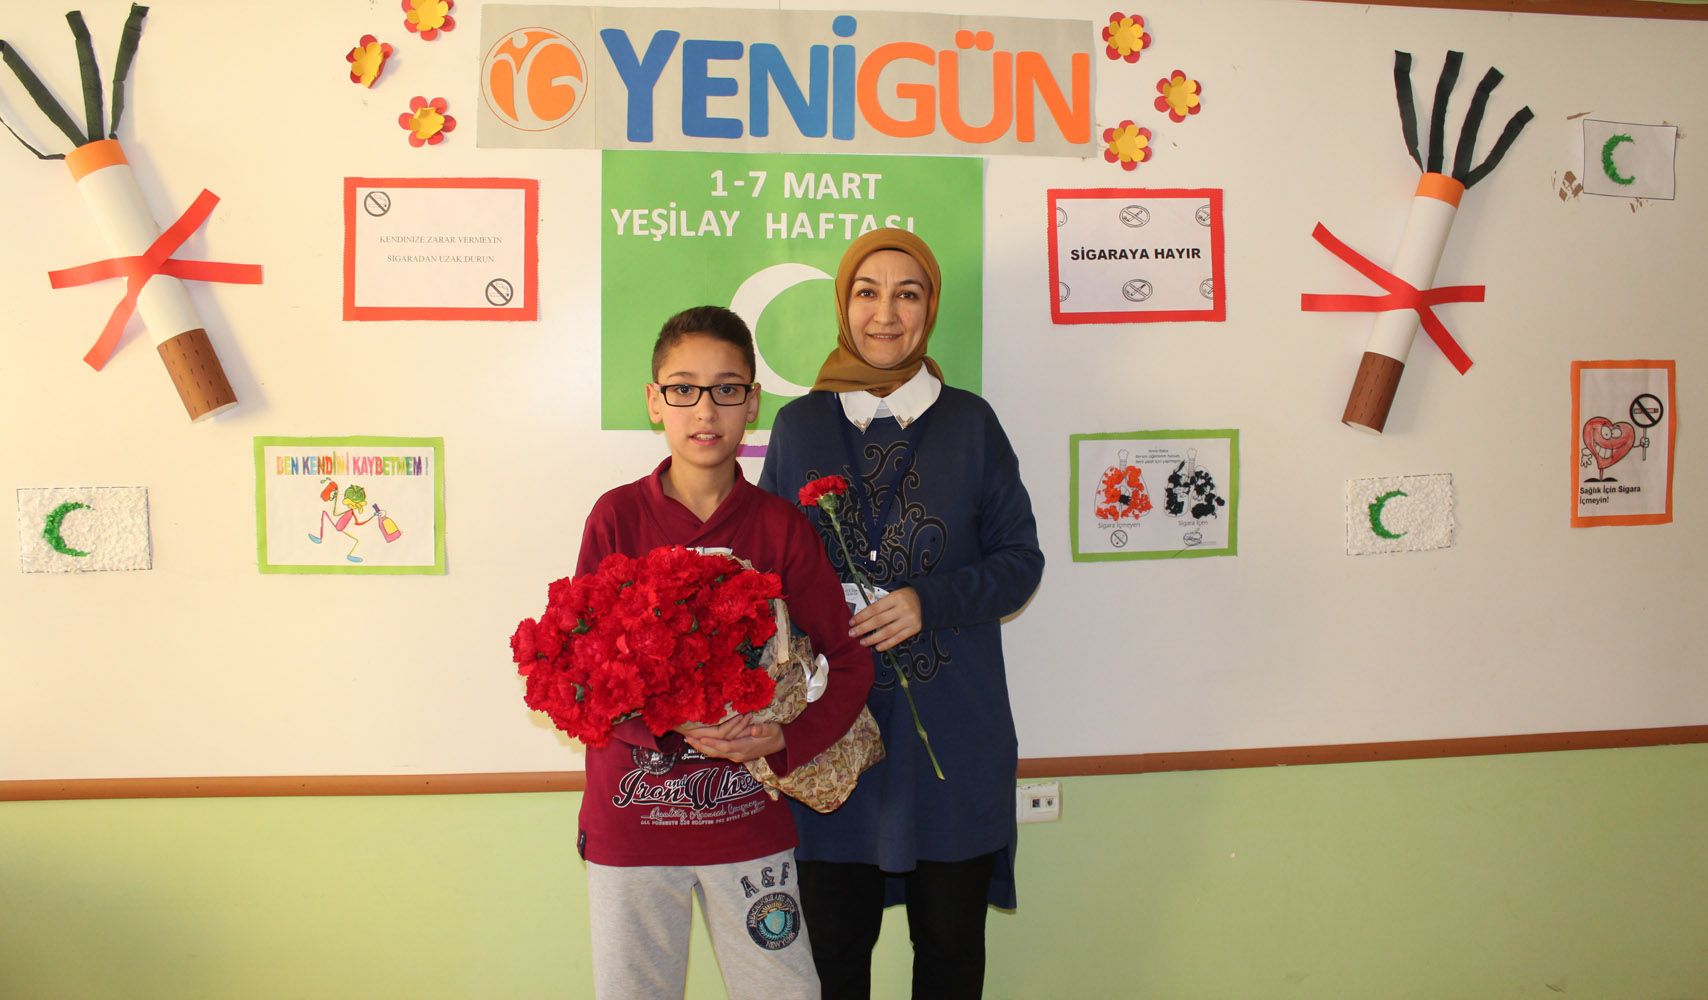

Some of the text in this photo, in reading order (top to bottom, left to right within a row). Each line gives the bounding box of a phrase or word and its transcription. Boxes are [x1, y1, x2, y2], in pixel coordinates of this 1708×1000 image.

[600, 15, 1091, 144] YENİGÜN
[710, 169, 882, 200] 1-7 MART
[610, 202, 740, 242] YEŞİLAY
[427, 235, 456, 244] ZARAR
[439, 255, 463, 263] UZAK
[464, 255, 495, 263] DURUN
[1070, 246, 1202, 261] SİGARAYA HAYIR
[276, 456, 299, 476] BEN
[353, 455, 423, 476] KAYBETMEM
[1580, 487, 1601, 495] Sağlık
[1618, 485, 1641, 494] Sigara
[612, 767, 688, 808] Iron
[665, 775, 688, 790] and
